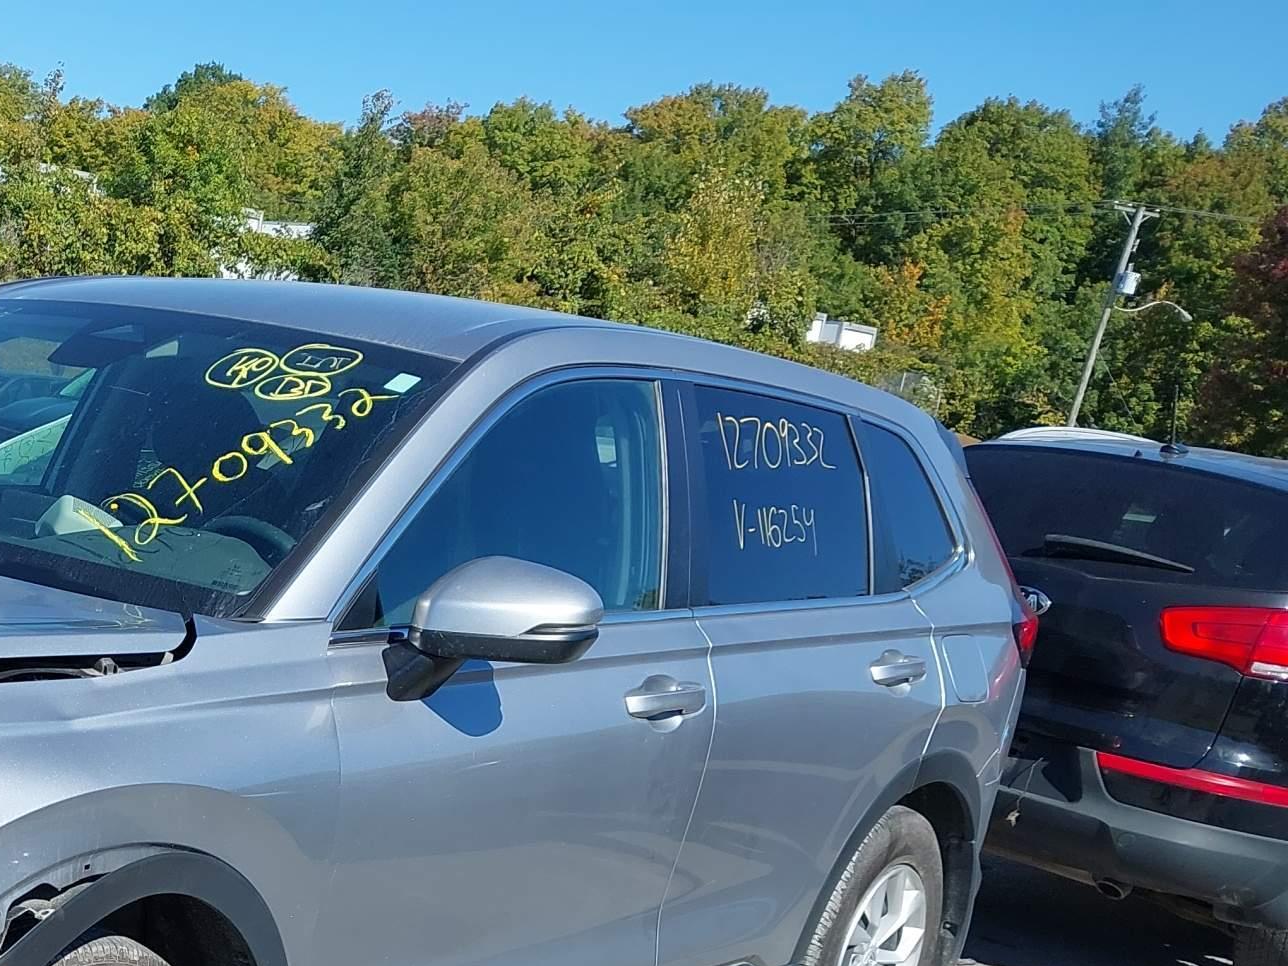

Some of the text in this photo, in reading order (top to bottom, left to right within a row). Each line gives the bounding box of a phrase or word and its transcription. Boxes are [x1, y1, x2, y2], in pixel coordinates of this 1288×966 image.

[715, 411, 837, 471] 12709332
[75, 388, 400, 562] 12709332
[732, 498, 819, 556] V-116254
